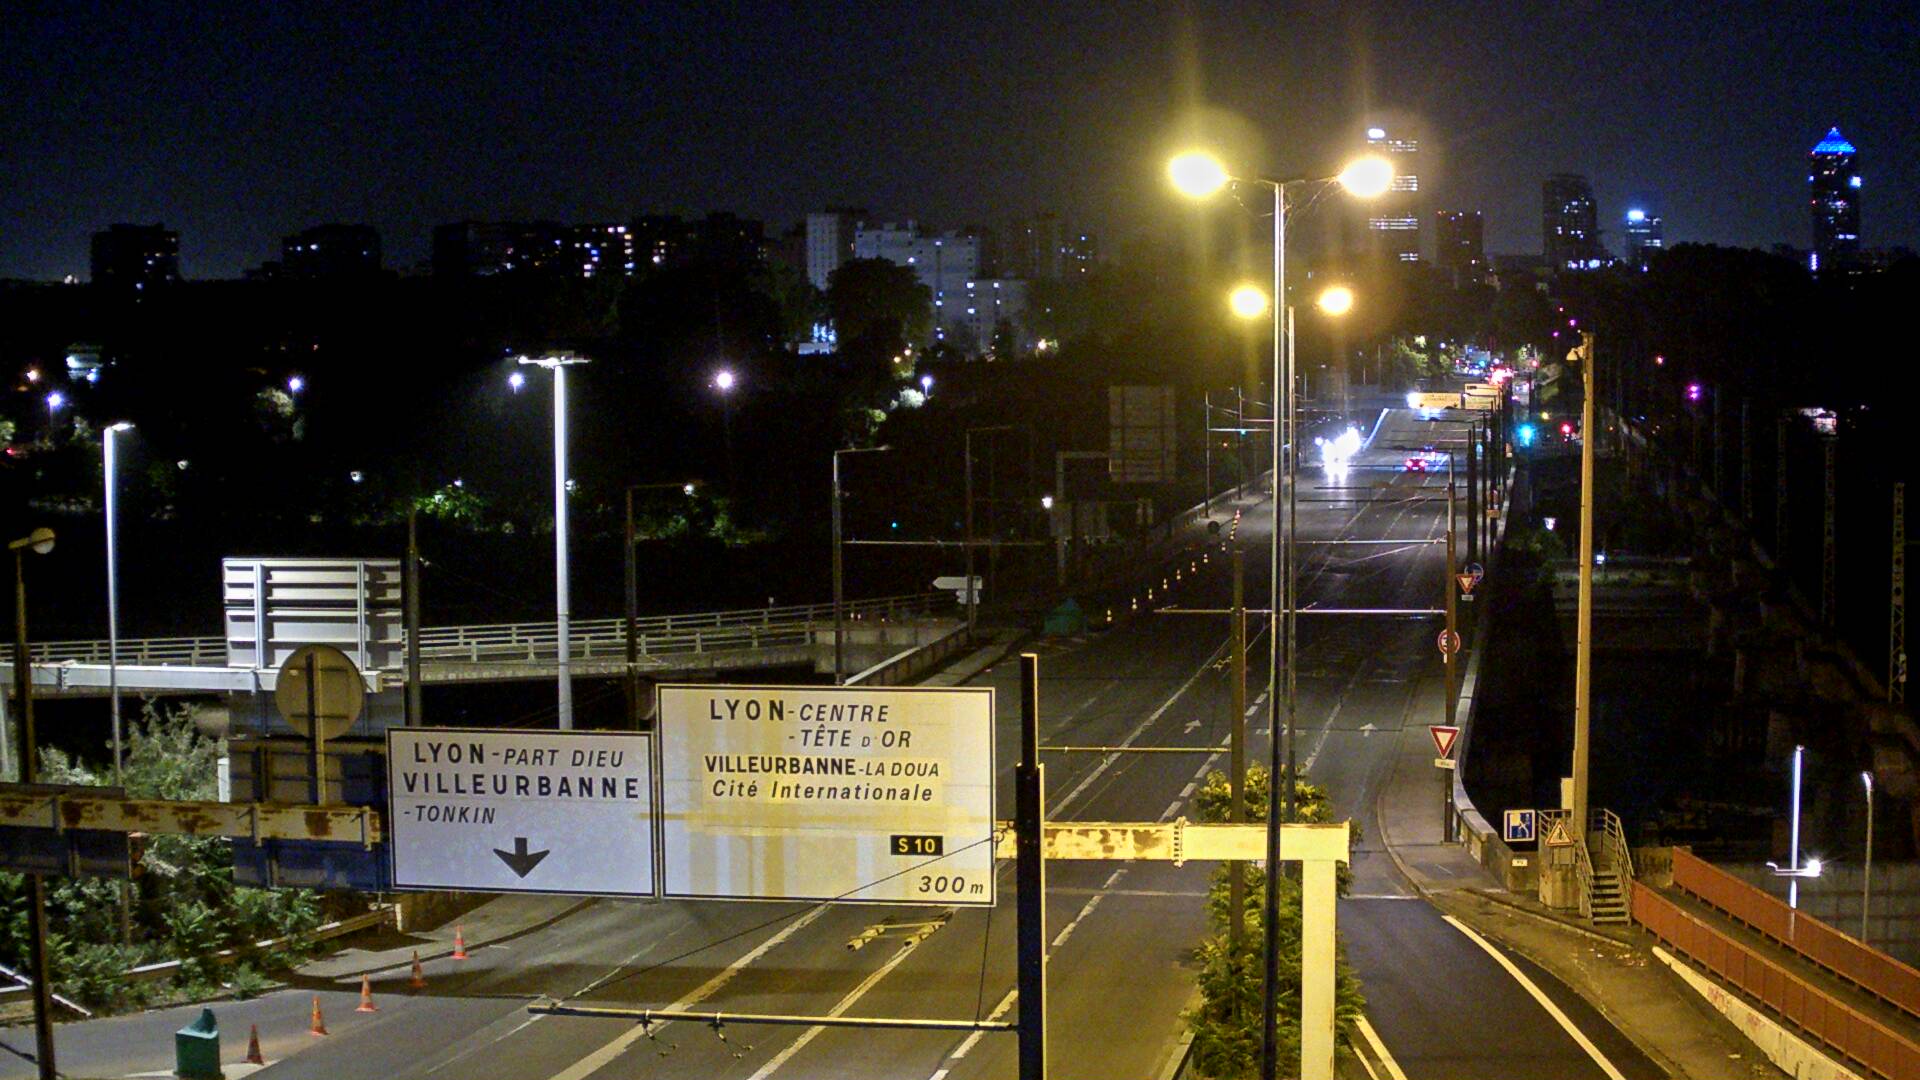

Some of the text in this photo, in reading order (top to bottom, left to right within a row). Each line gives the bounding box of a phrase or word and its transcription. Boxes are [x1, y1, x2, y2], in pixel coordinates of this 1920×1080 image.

[571, 750, 624, 768] DIEU
[890, 763, 940, 777] DOUA
[403, 772, 639, 799] VILLEURBANNE
[712, 780, 933, 801] Cité Internationale
[918, 875, 984, 894] 300 m
